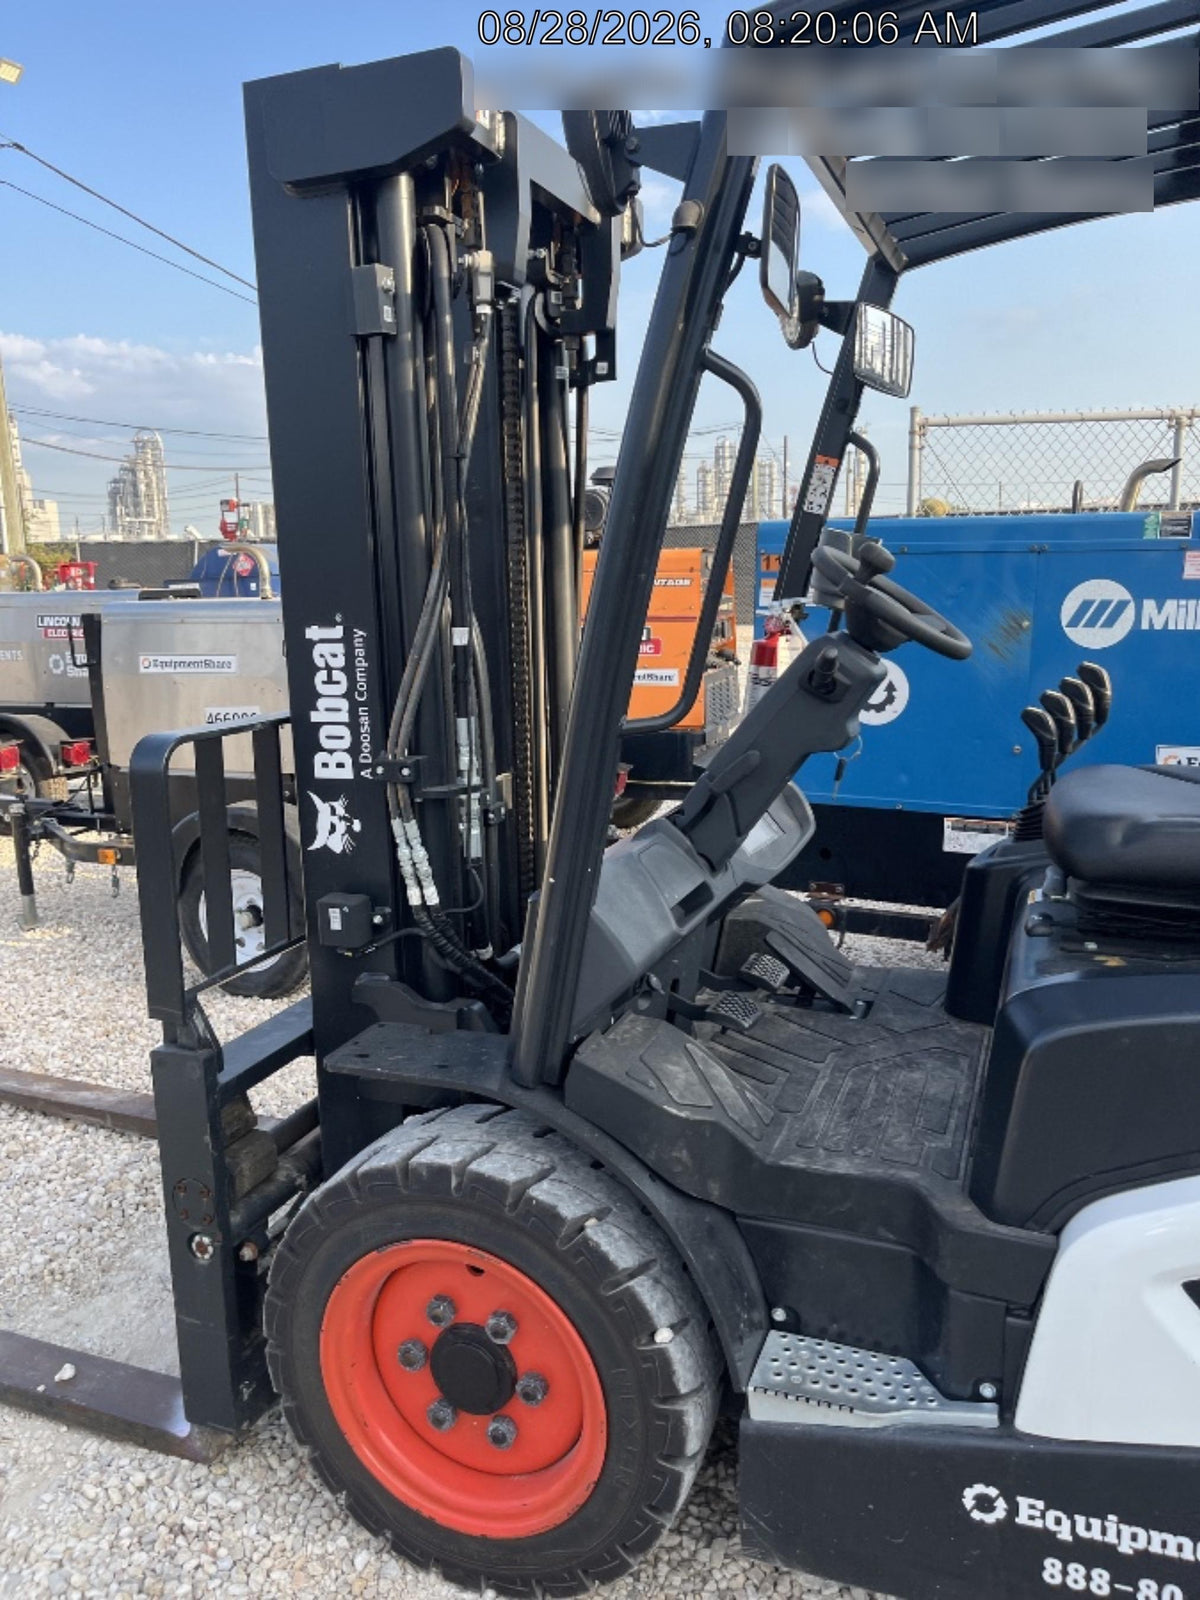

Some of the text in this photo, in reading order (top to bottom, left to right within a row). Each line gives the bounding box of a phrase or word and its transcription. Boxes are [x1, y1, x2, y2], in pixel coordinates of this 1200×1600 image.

[152, 659, 232, 669] EquipmentShare
[206, 712, 259, 724] 466
[305, 625, 354, 779] Bobcat
[353, 628, 373, 779] A Doosan Company
[1015, 1496, 1200, 1562] Equipm
